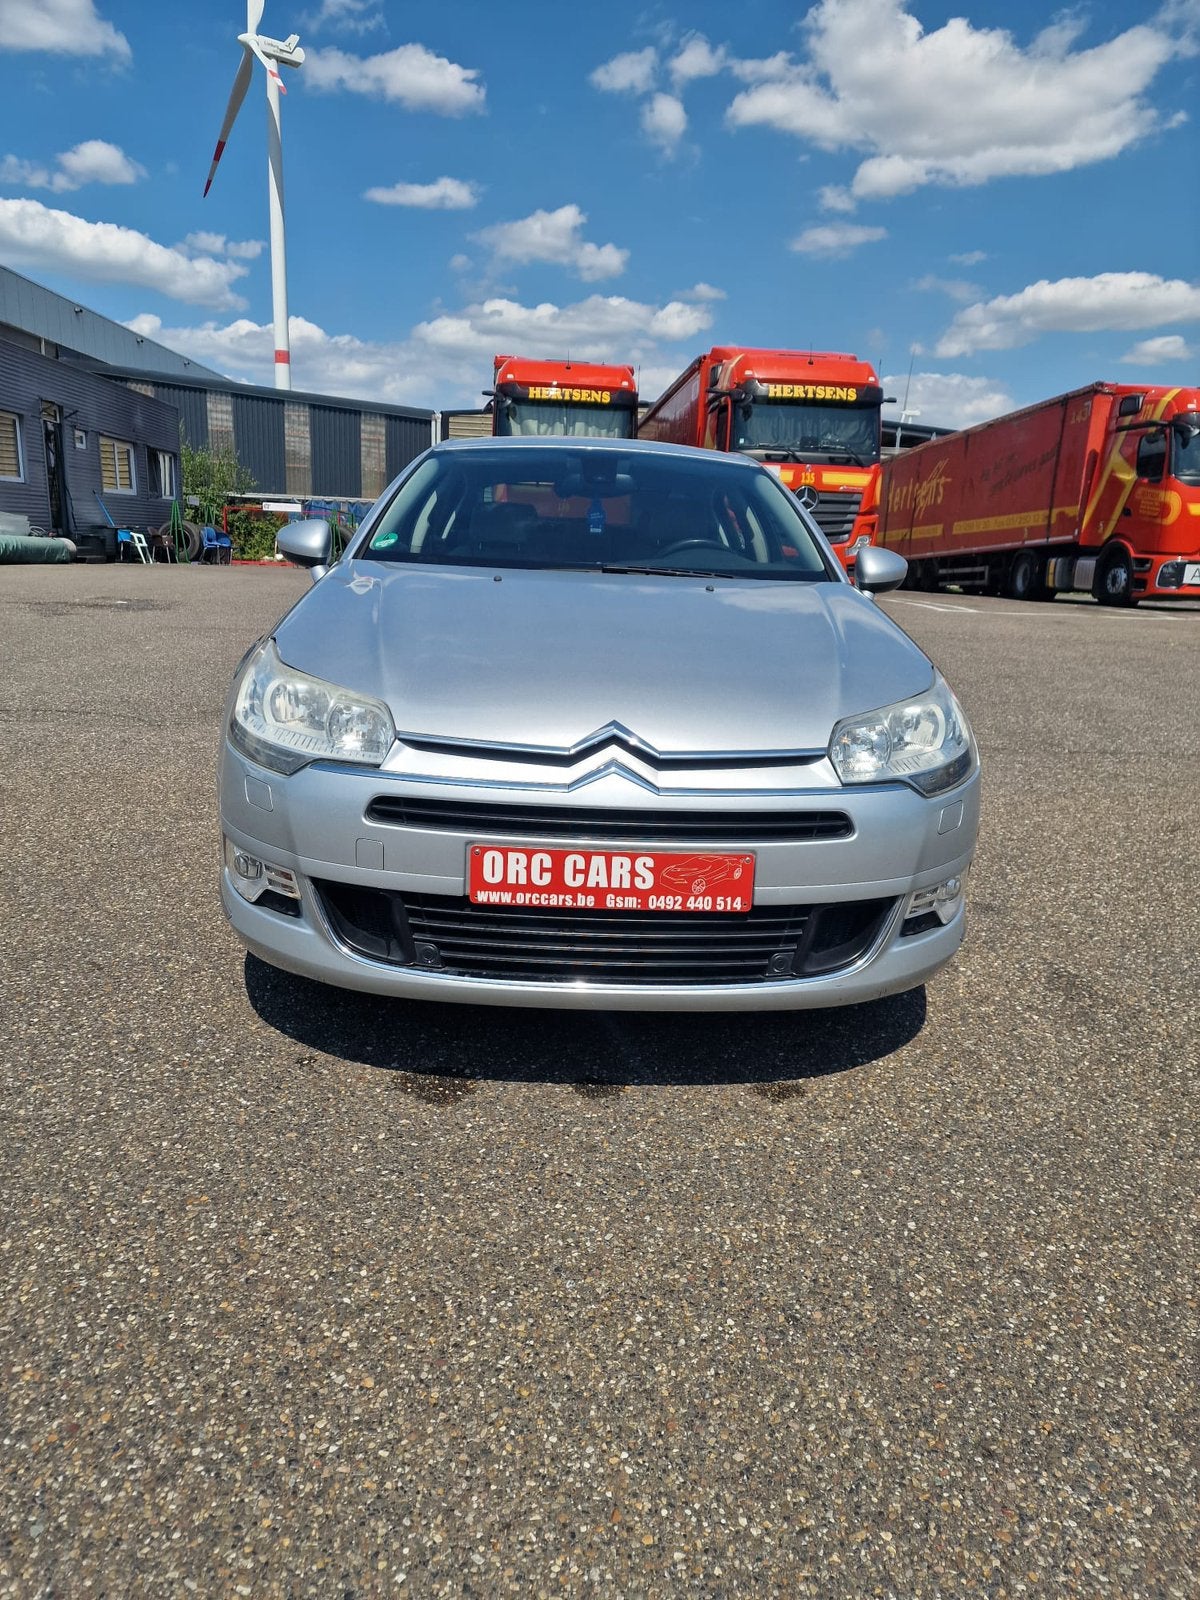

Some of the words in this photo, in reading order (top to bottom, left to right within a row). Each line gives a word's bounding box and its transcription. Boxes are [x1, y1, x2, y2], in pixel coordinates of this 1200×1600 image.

[528, 386, 611, 403] HERTSENS
[768, 384, 857, 401] HERTSENS
[801, 472, 815, 484] 135
[482, 850, 552, 886] ORC
[563, 854, 655, 890] CARS
[476, 890, 595, 907] www.orccars.be
[605, 893, 642, 908] Gsm:
[648, 895, 683, 910] 0492
[686, 896, 712, 910] 440
[716, 896, 742, 910] 514
